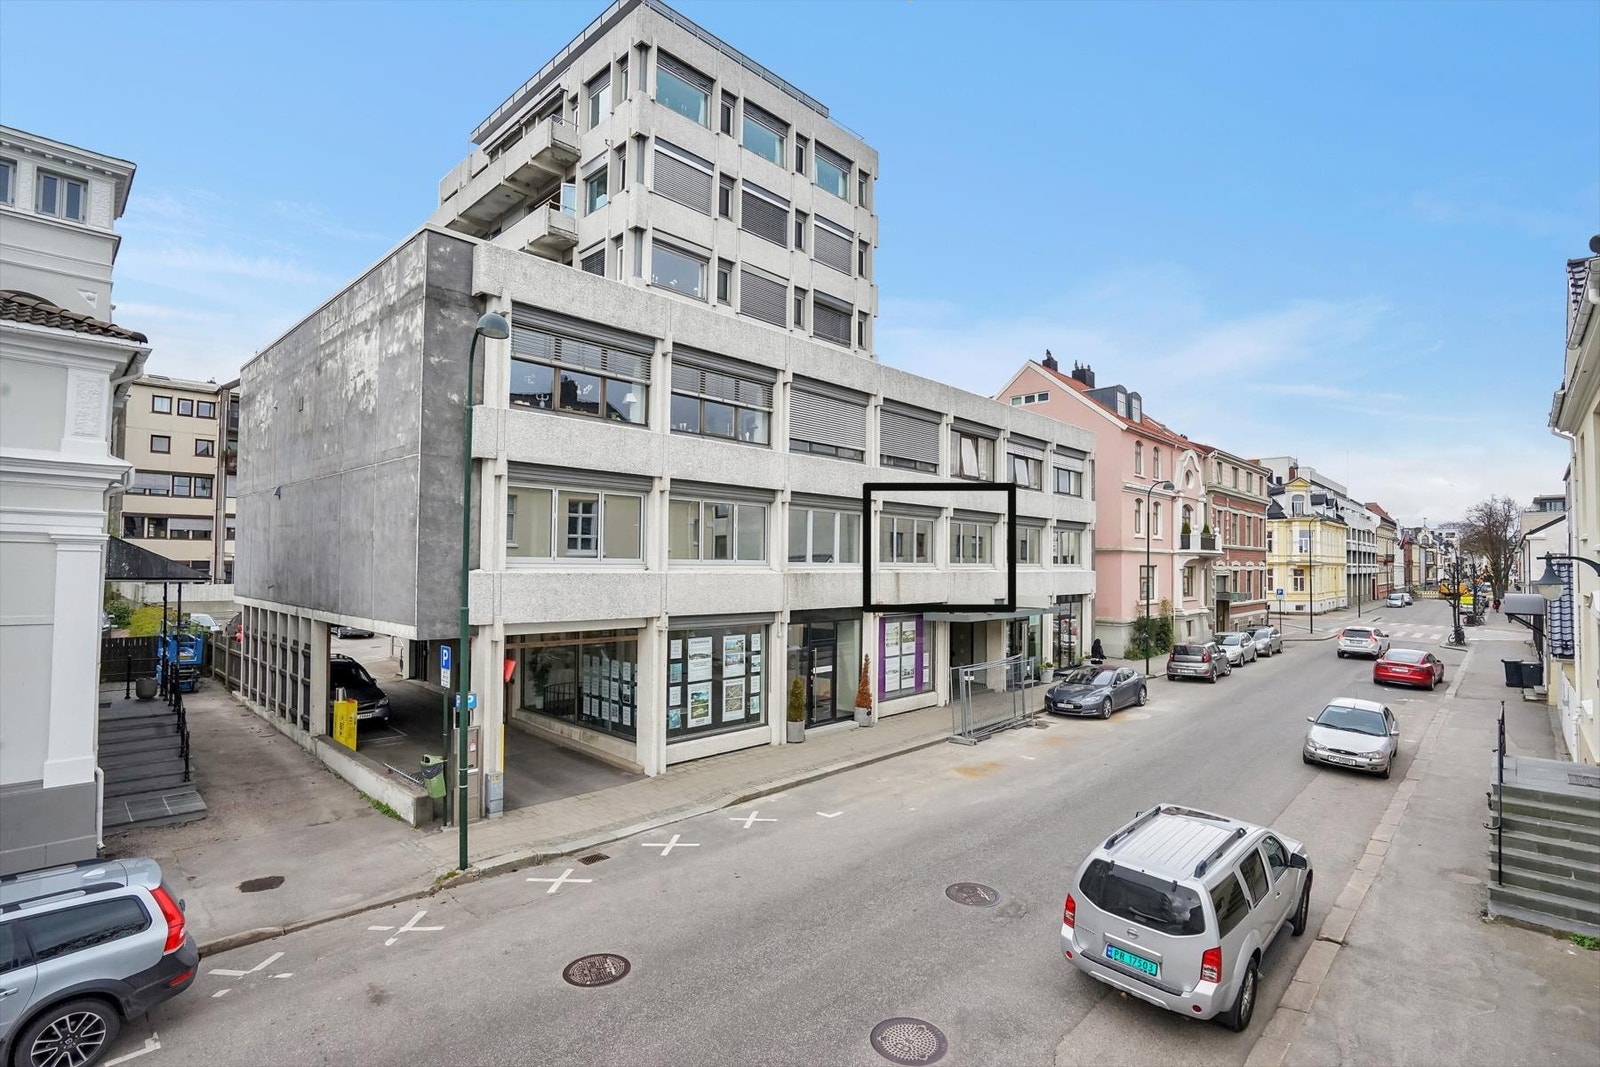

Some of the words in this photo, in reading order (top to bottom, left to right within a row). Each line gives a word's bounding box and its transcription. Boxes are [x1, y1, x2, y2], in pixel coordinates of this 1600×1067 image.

[443, 649, 448, 666] P
[1114, 949, 1125, 960] PR
[1128, 956, 1153, 971] 17503
